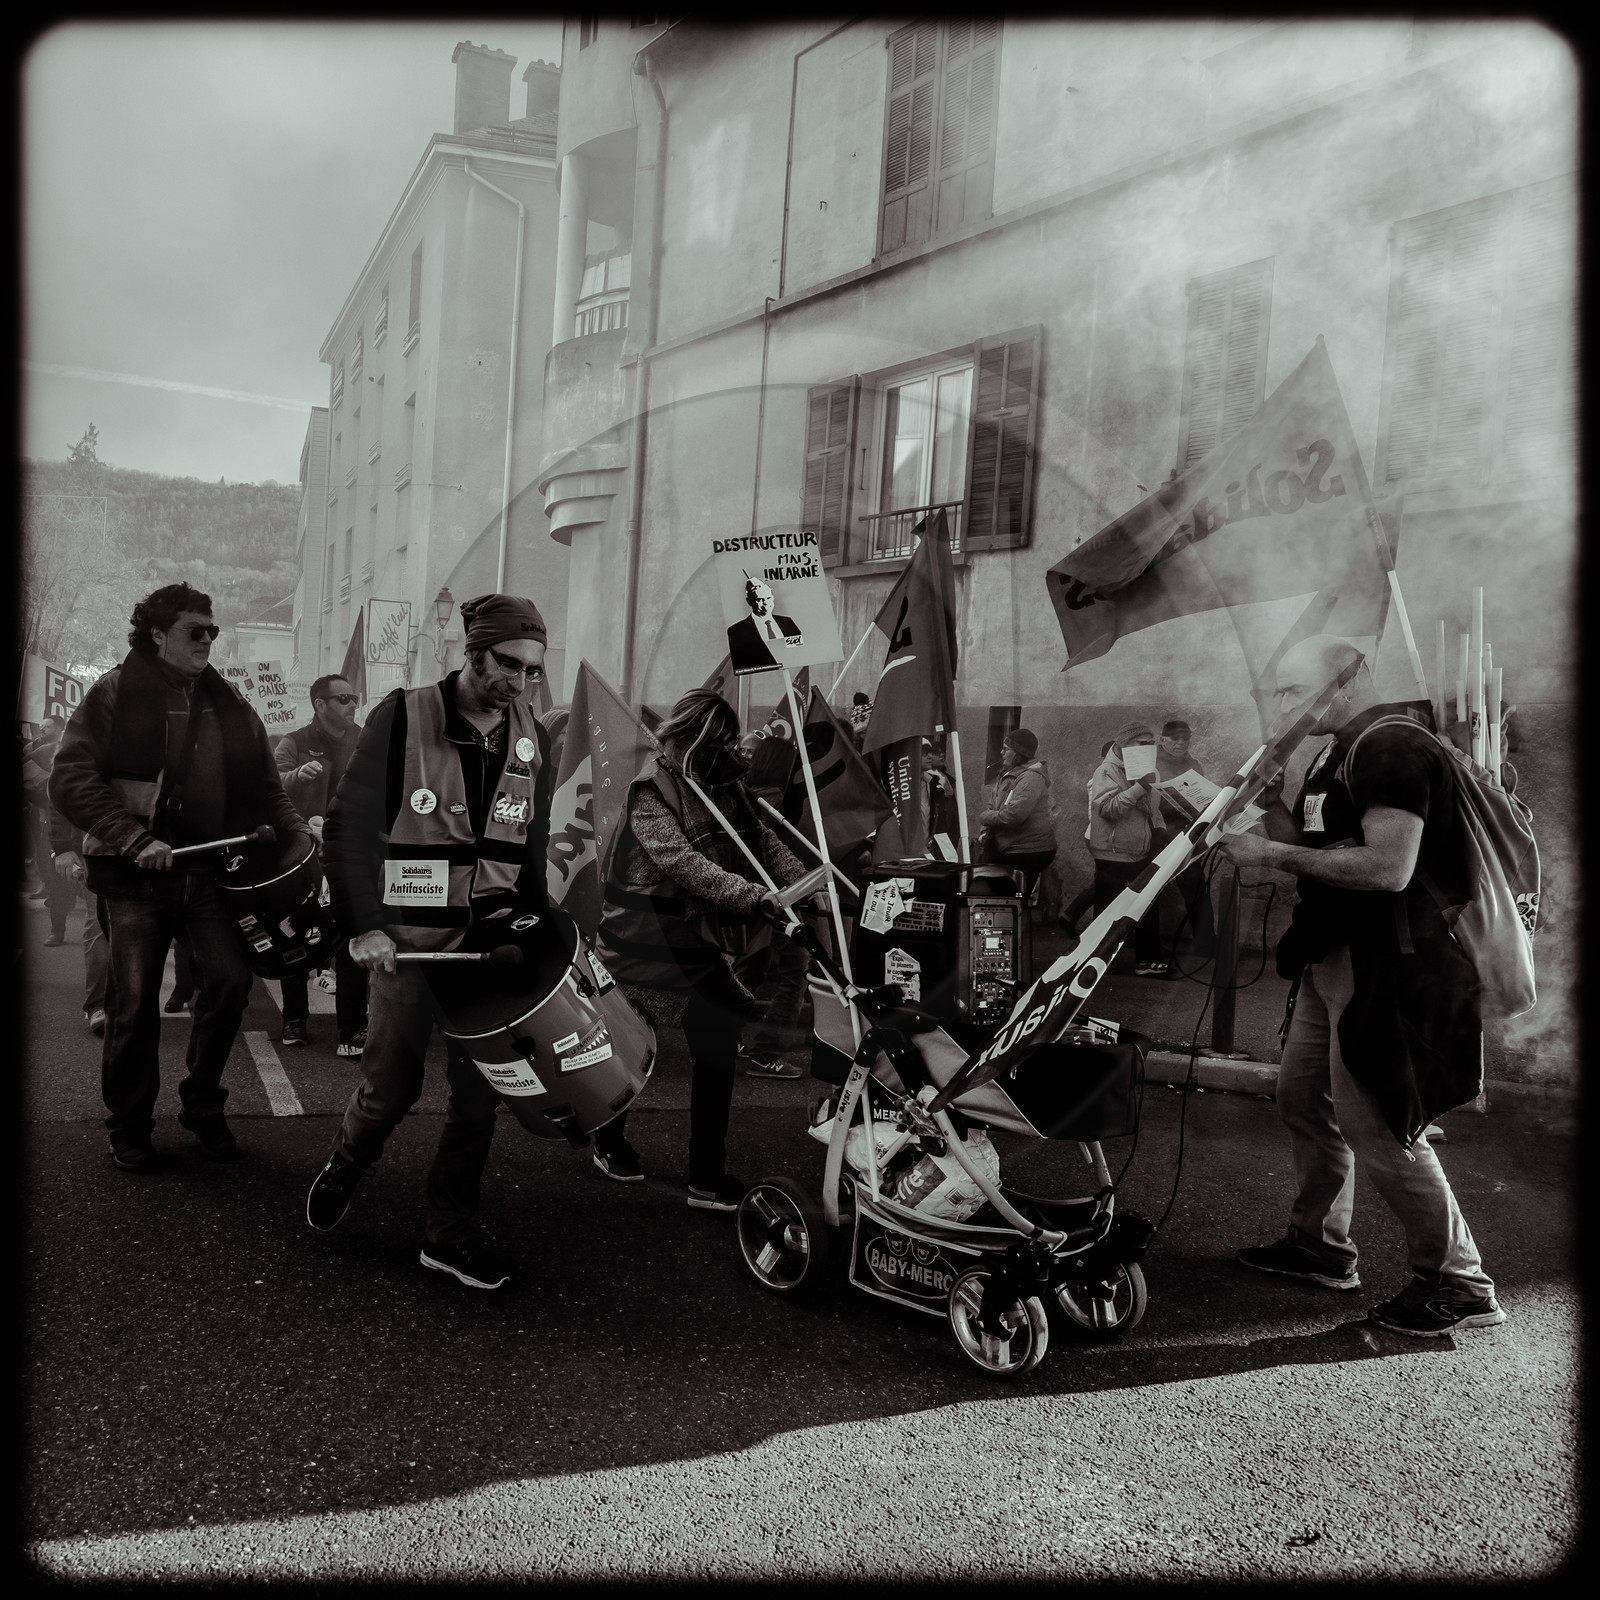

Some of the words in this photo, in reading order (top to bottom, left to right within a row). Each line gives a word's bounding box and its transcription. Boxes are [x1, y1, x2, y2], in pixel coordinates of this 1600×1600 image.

[712, 531, 818, 554] DESTRUCTEUR
[258, 673, 282, 683] NOUS
[267, 699, 284, 710] NOS
[898, 755, 912, 801] Union
[401, 866, 433, 875] Solidaires
[389, 882, 444, 894] Antifasciste
